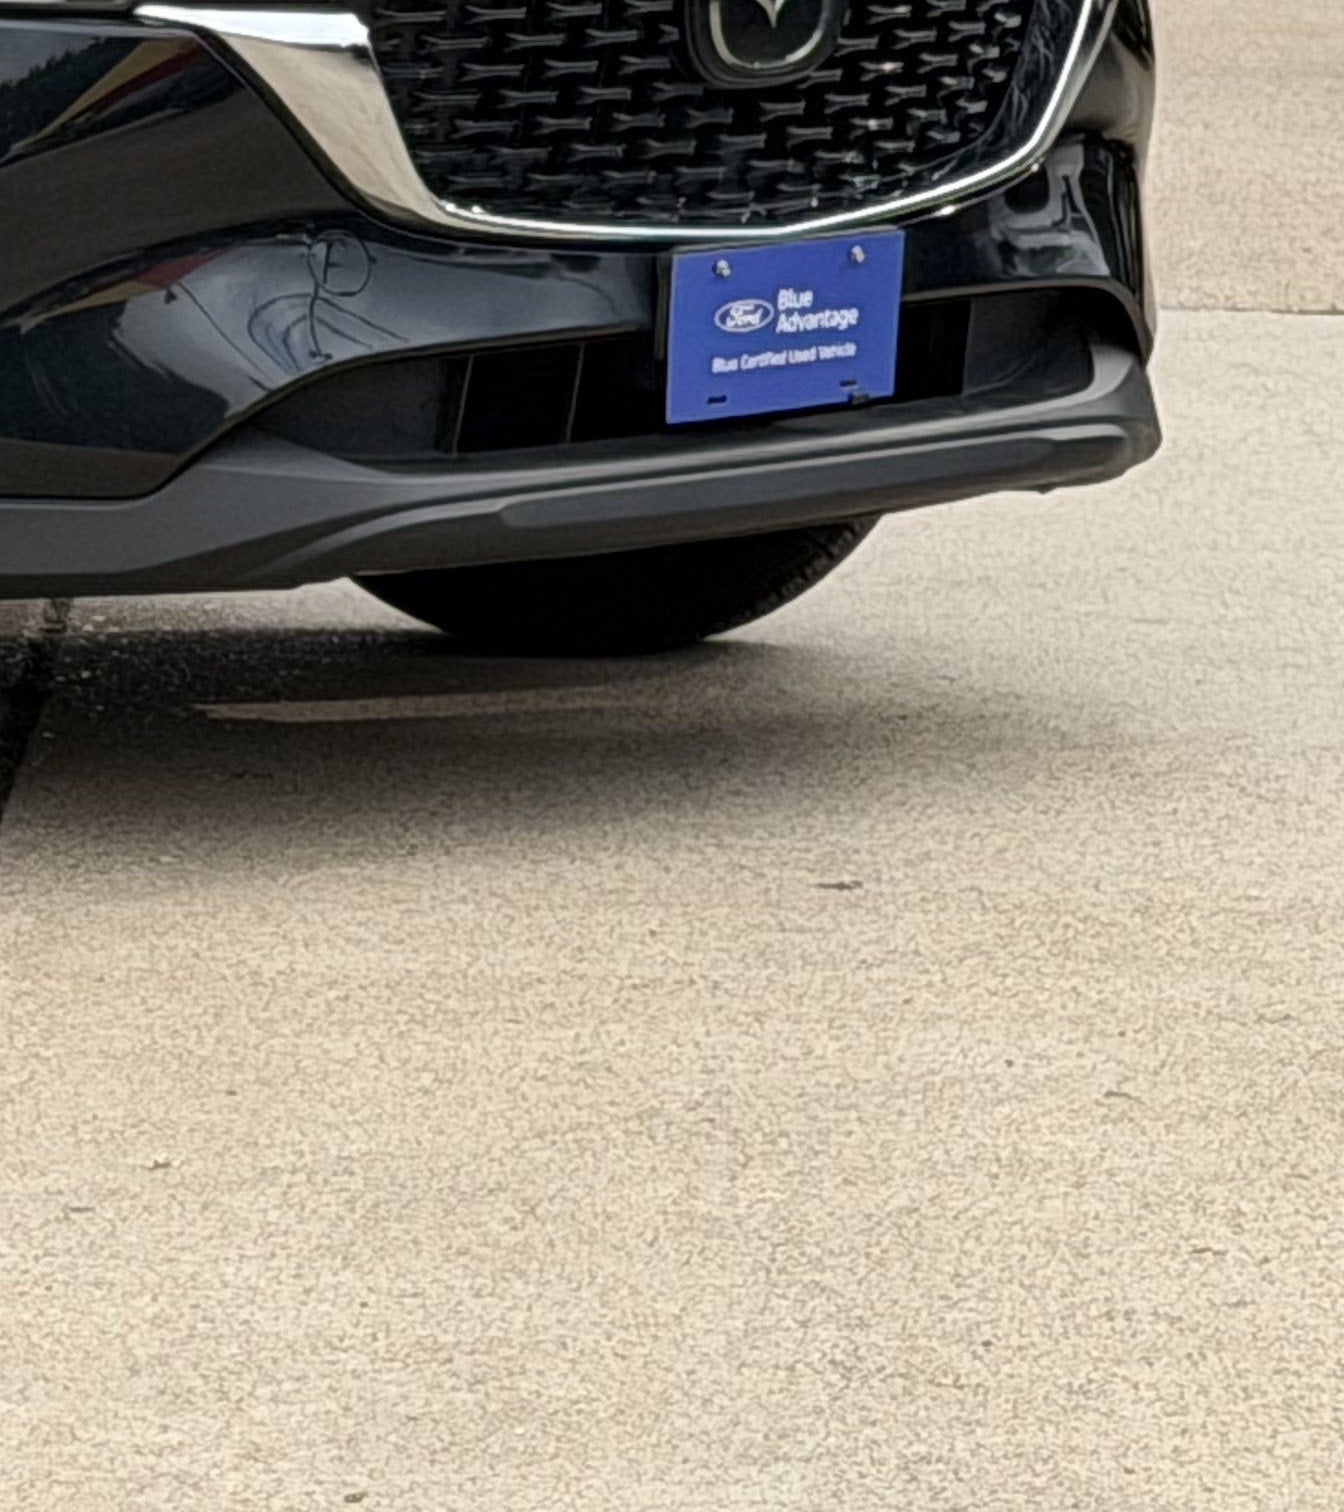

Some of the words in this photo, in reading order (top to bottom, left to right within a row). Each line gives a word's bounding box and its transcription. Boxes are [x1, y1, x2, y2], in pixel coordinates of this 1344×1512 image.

[777, 287, 814, 311] Blue
[775, 307, 859, 334] Advantage
[712, 356, 739, 374] Blue
[740, 350, 787, 371] Certified
[787, 346, 817, 364] Used
